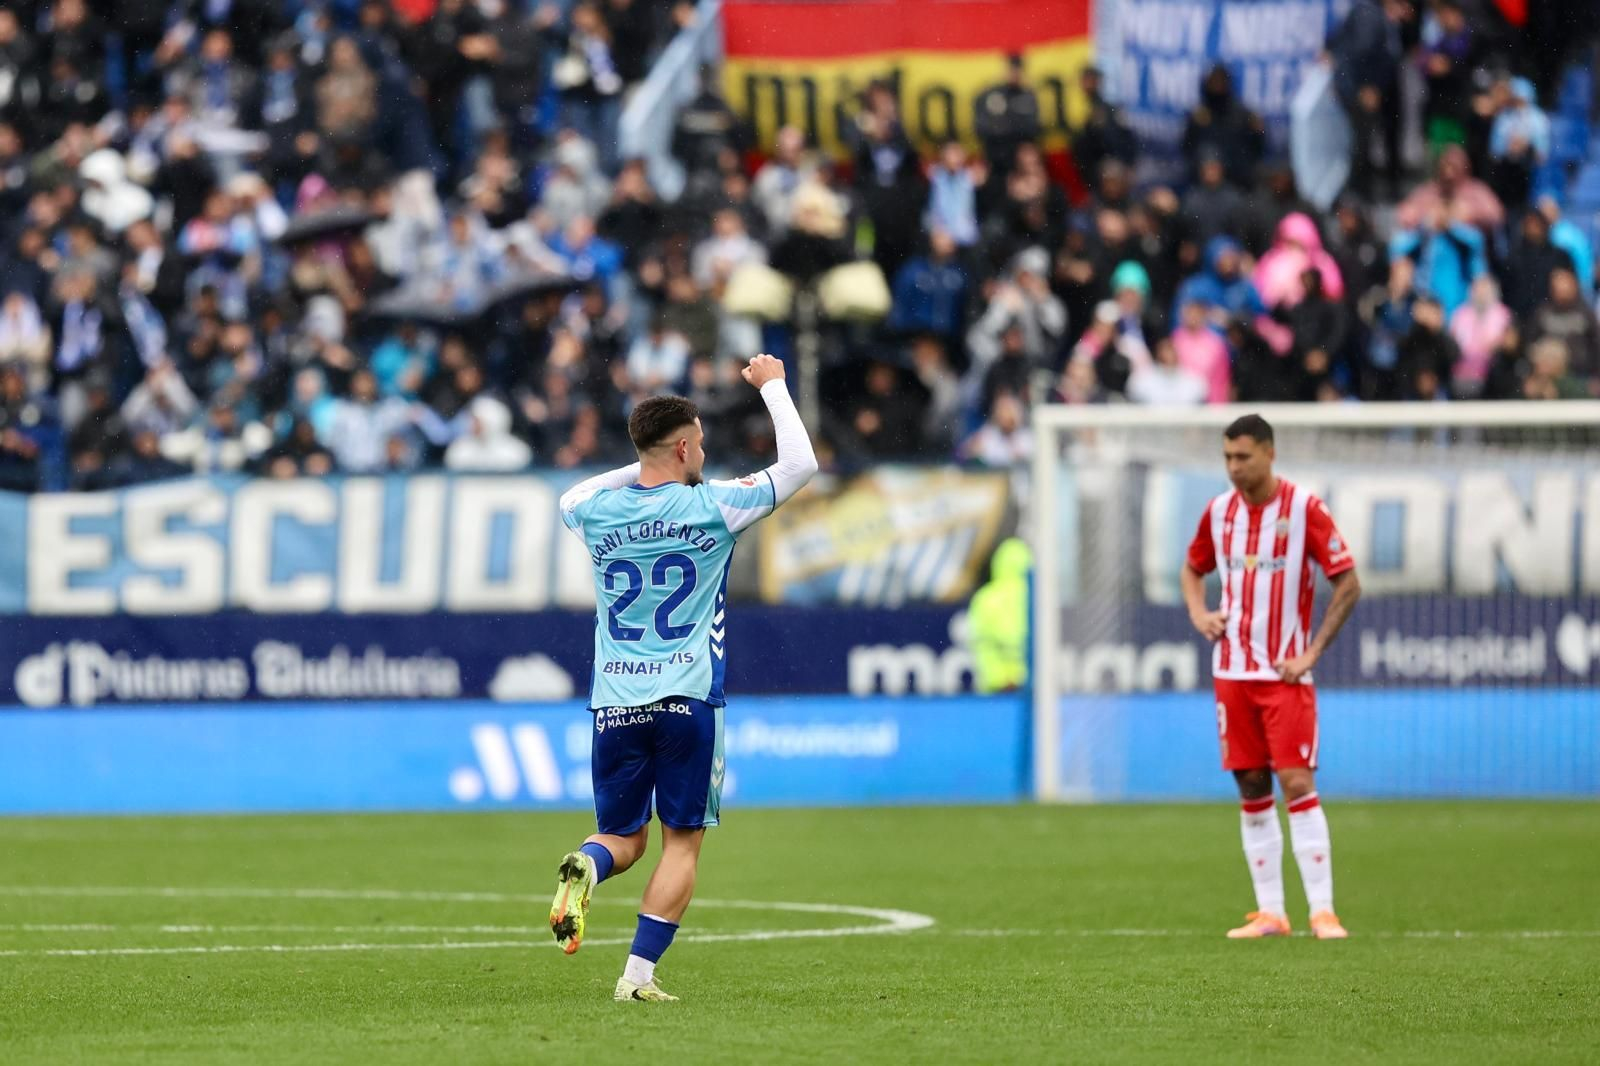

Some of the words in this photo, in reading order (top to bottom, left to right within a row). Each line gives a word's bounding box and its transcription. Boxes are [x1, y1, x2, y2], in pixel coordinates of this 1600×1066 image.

[626, 519, 718, 553] LORENZO
[603, 552, 698, 642] 22
[1360, 625, 1547, 687] Hospital
[606, 713, 654, 729] MÁLAGA
[668, 702, 693, 716] SOL
